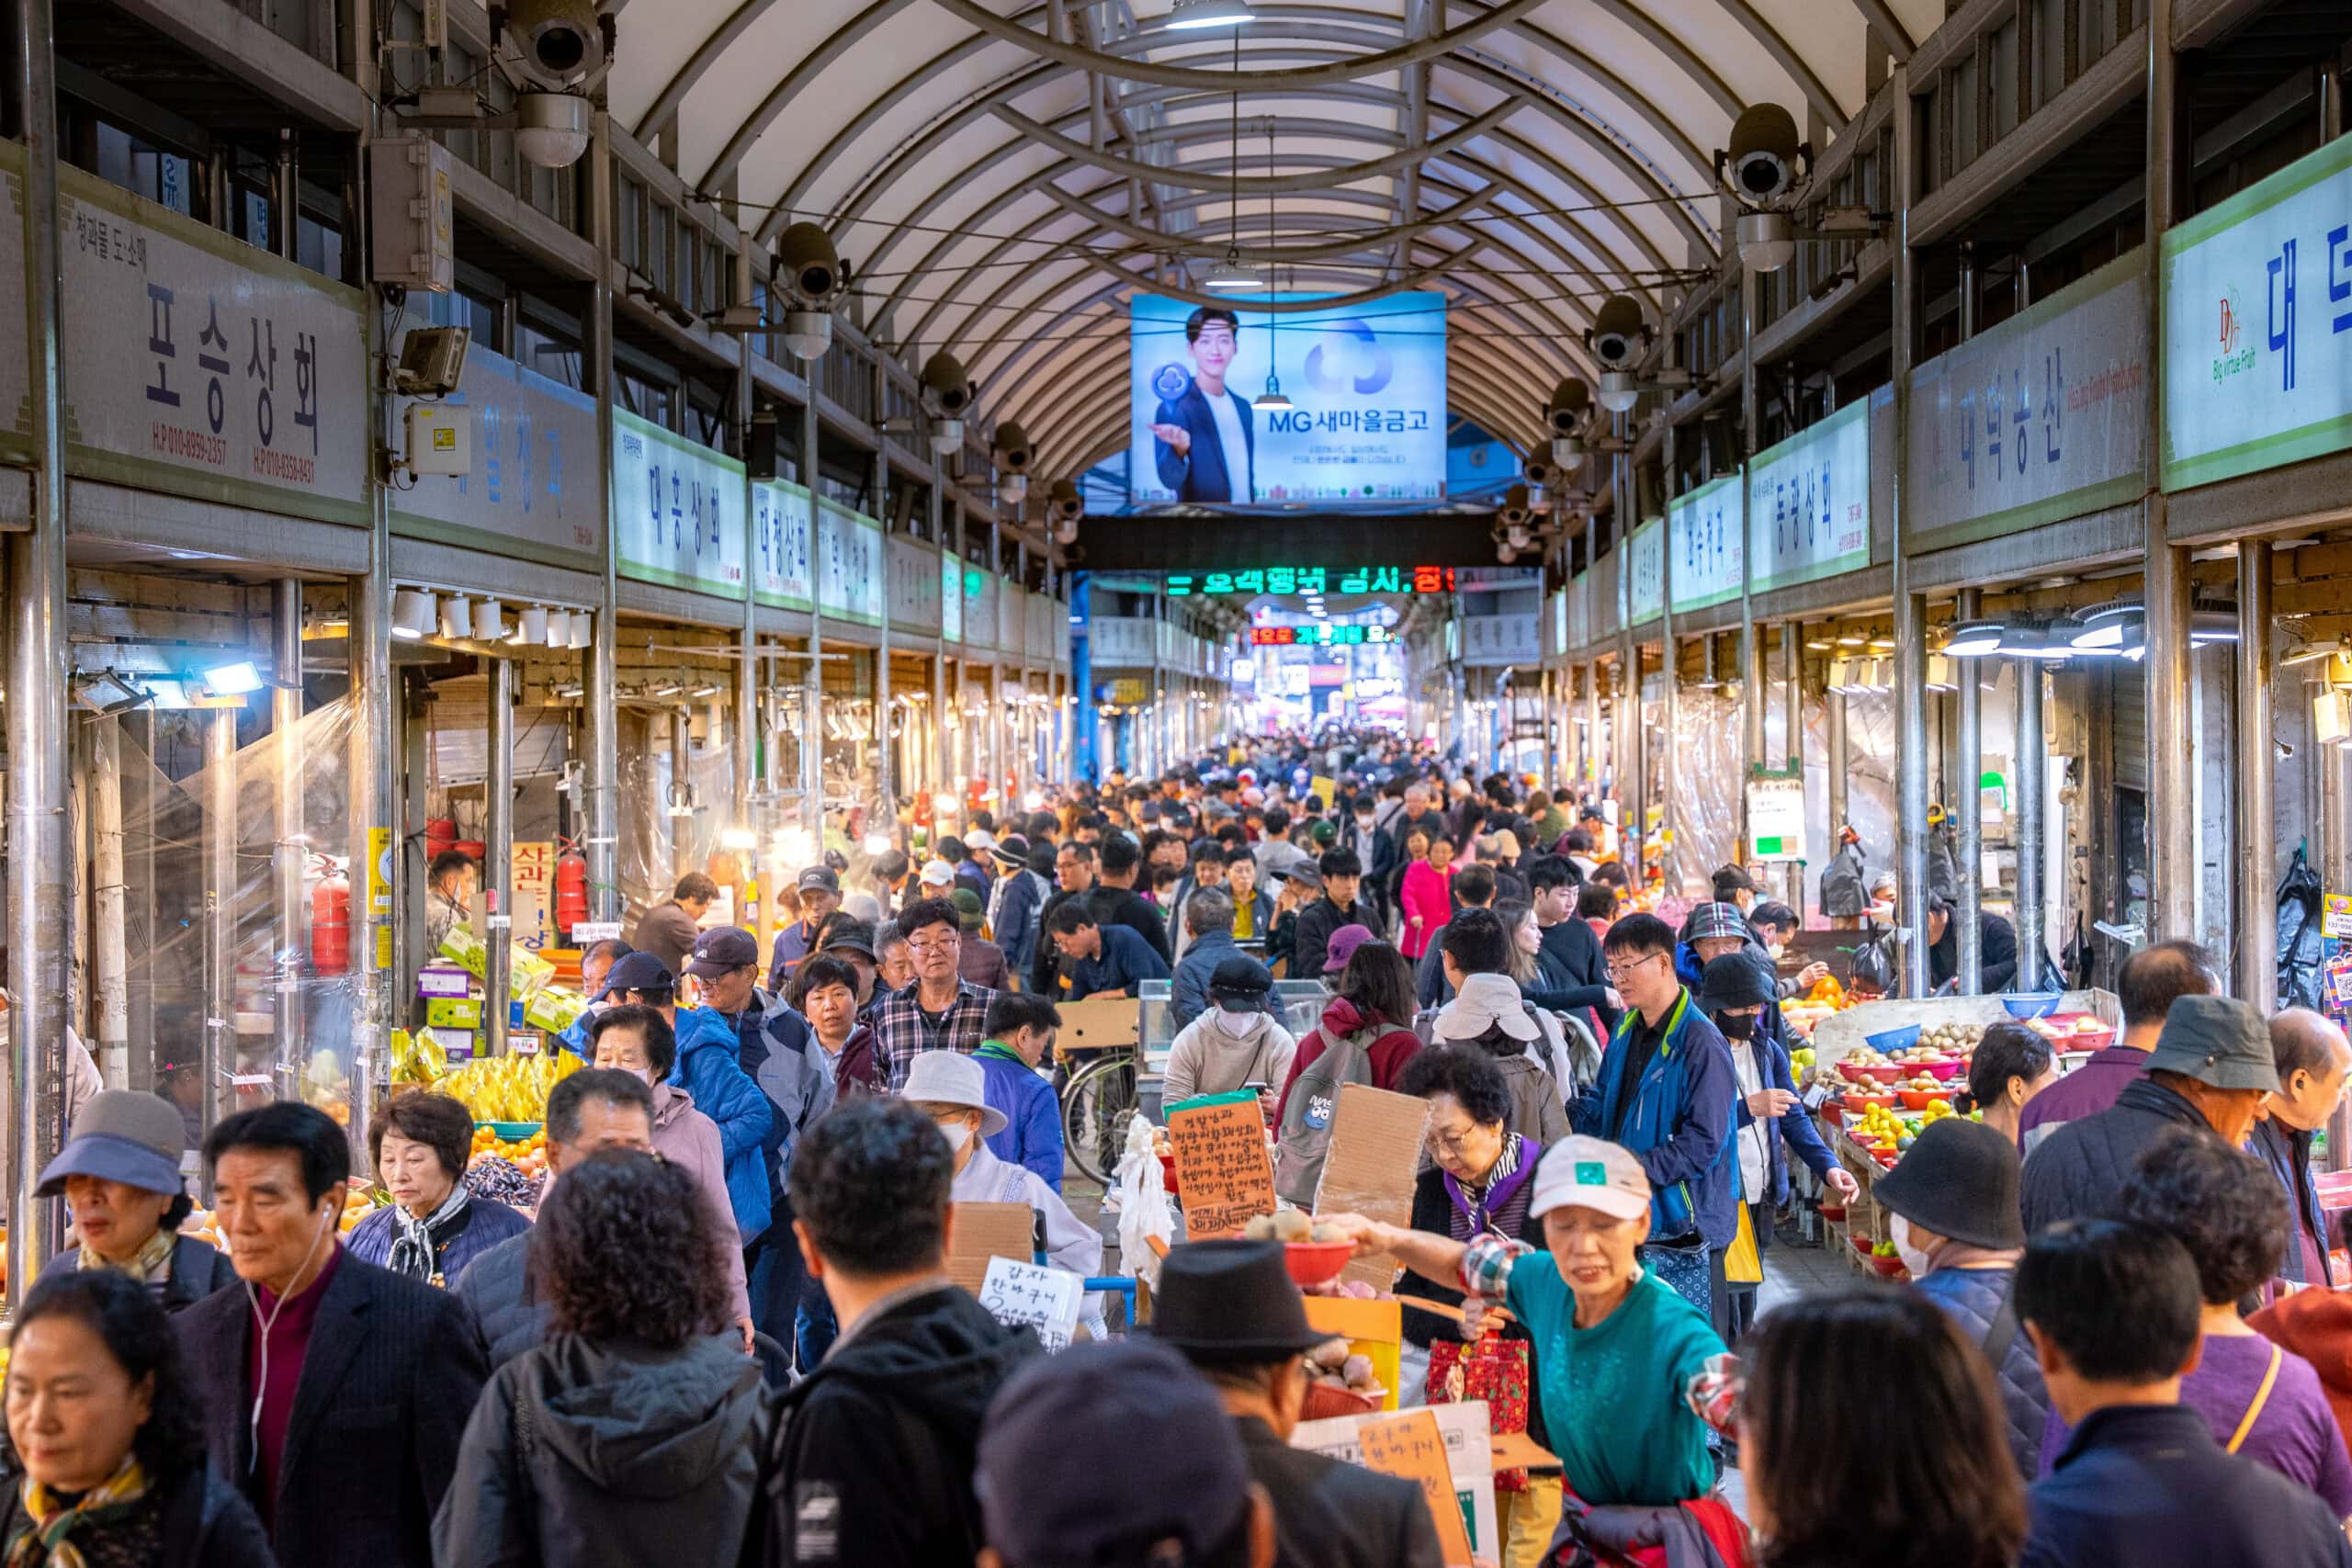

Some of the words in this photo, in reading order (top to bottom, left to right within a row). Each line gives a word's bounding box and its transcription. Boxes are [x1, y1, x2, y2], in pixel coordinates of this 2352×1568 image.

[146, 282, 318, 456] 포승상회
[649, 463, 720, 561] 대흥상회
[1008, 1265, 1049, 1282] 감자
